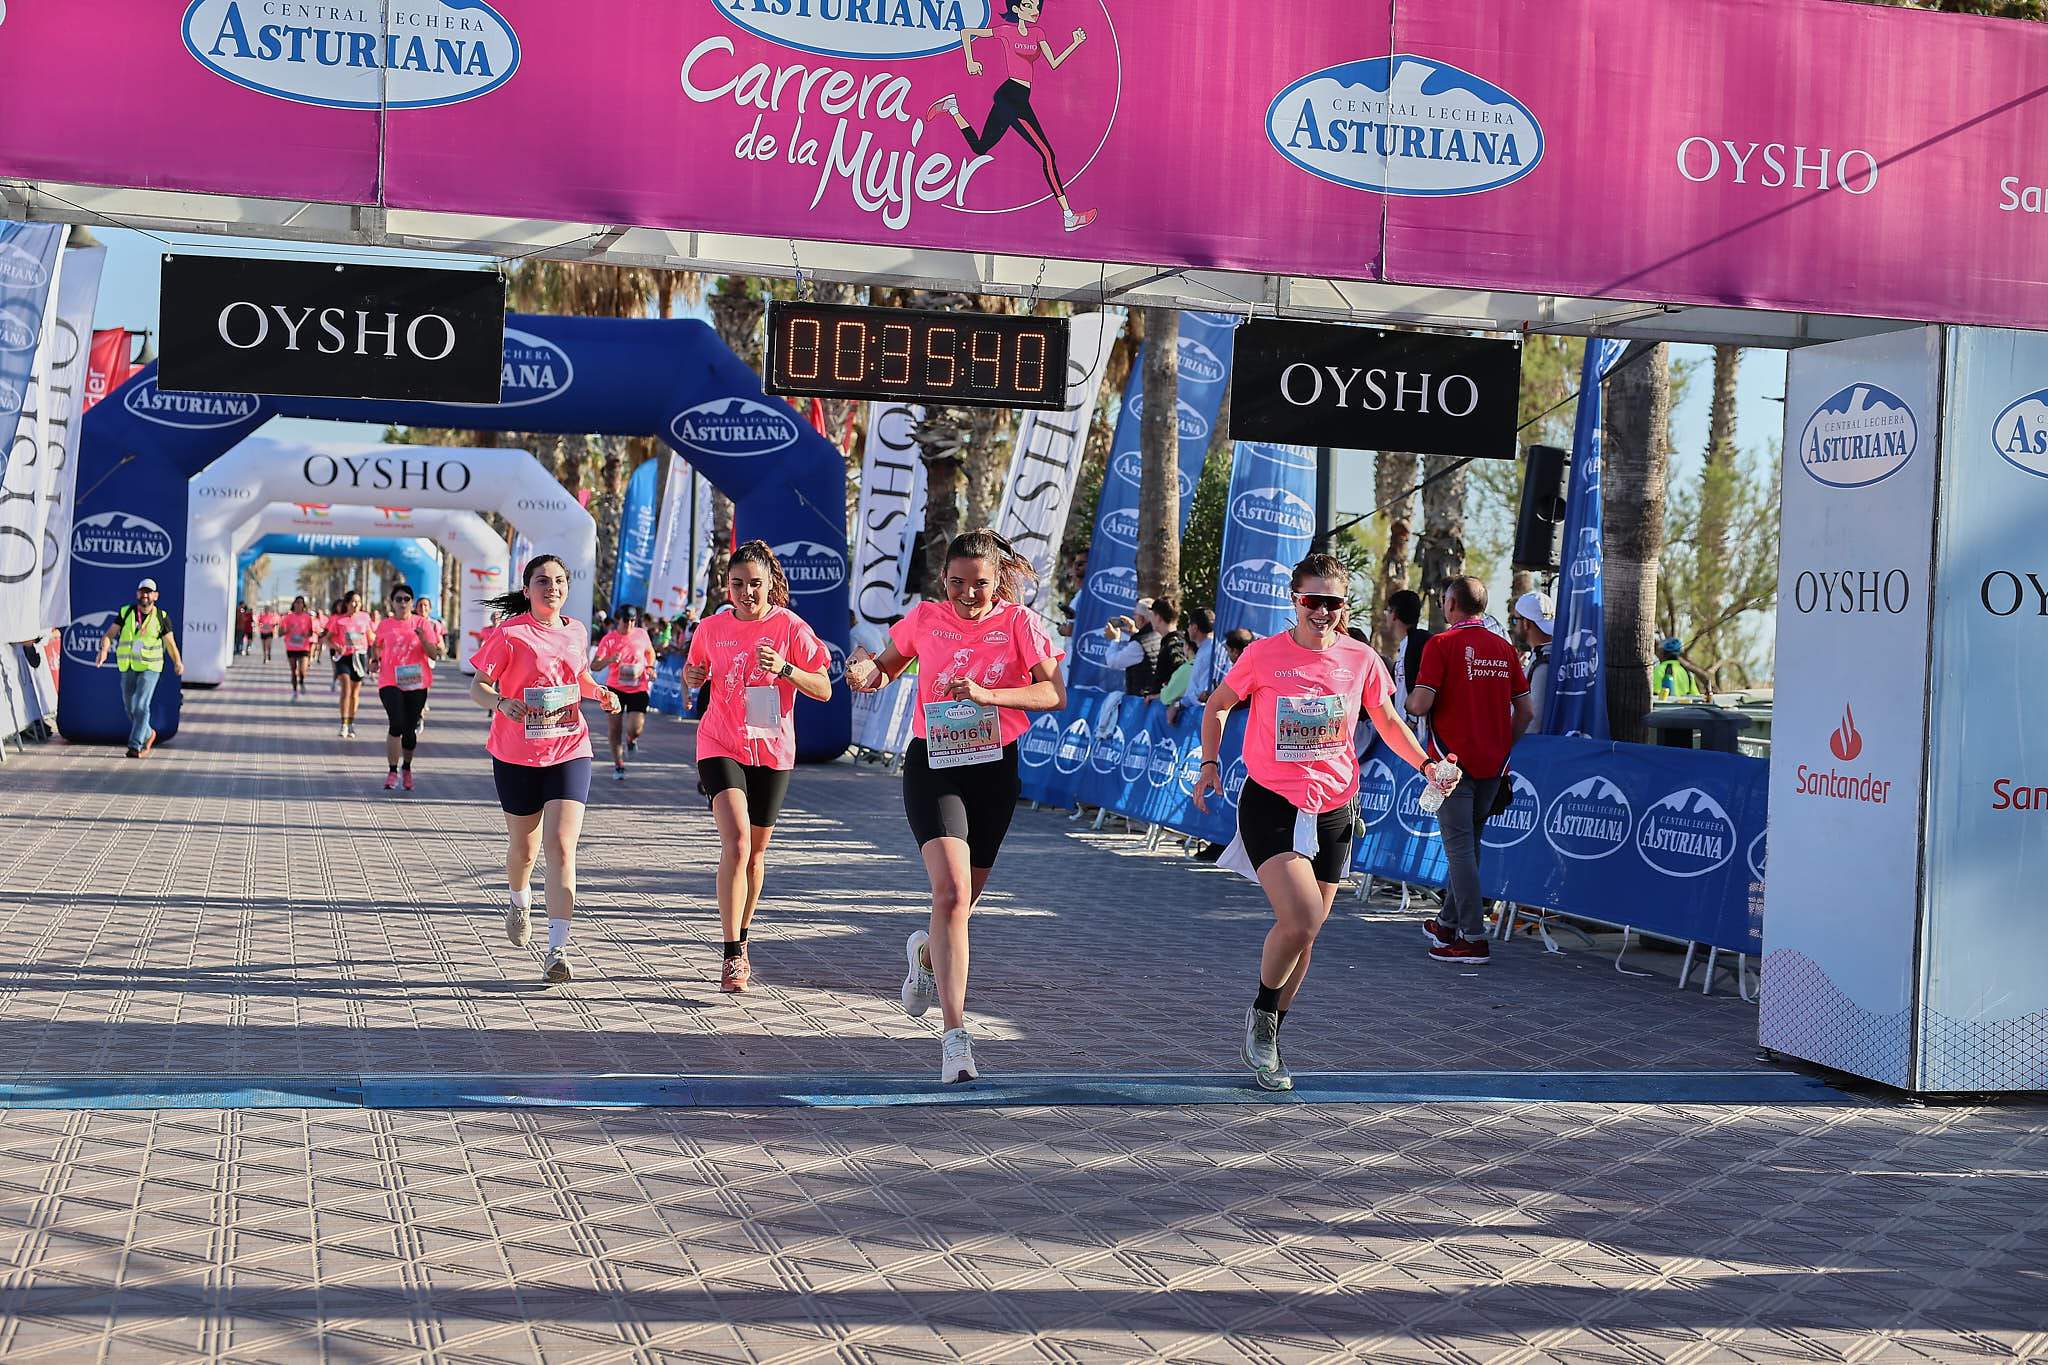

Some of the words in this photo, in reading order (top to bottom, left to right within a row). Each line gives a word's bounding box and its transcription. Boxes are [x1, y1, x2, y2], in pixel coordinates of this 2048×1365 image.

[263, 1, 367, 23] CENTRAL
[207, 1, 494, 77] ASTURIANA
[1013, 42, 1039, 52] OYSHO
[680, 35, 912, 122] Carrera
[1332, 98, 1418, 117] CENTRAL
[1428, 106, 1515, 126] LECHERA
[1287, 97, 1522, 166] ASTURIANA
[734, 113, 778, 161] de
[787, 115, 819, 166] la
[809, 117, 995, 230] Mujer
[1676, 135, 1879, 196] OYSHO
[1999, 175, 2048, 214] Sa
[217, 300, 456, 362] OYSHO
[132, 387, 249, 416] ASTURIANA
[1279, 361, 1479, 418] OYSHO
[682, 419, 791, 442] ASTURIANA
[1824, 417, 1861, 433] CENTRAL
[1864, 413, 1905, 429] LECHERA
[1806, 426, 1908, 465] ASTURIANA
[303, 453, 471, 494] OYSHO
[199, 486, 251, 500] OYSHO
[517, 499, 567, 511] OYSHO
[1237, 499, 1313, 533] ASTURIANA
[73, 531, 165, 557] ASTURIANA
[1795, 568, 1910, 614] OYSHO
[184, 621, 218, 633] SHO
[932, 629, 962, 641] OYSHO
[1274, 670, 1306, 678] OYSHO
[1473, 659, 1509, 668] SPEAKER
[1474, 669, 1497, 677] TONY
[1497, 671, 1510, 679] GIL
[1796, 764, 1891, 804] Santander
[1567, 802, 1596, 813] CENTRAL
[1549, 803, 1624, 842] ASTURIANA
[1659, 815, 1690, 827] CENTRAL
[1691, 820, 1726, 834] LECHERA
[1641, 815, 1723, 860] ASTURIANA
